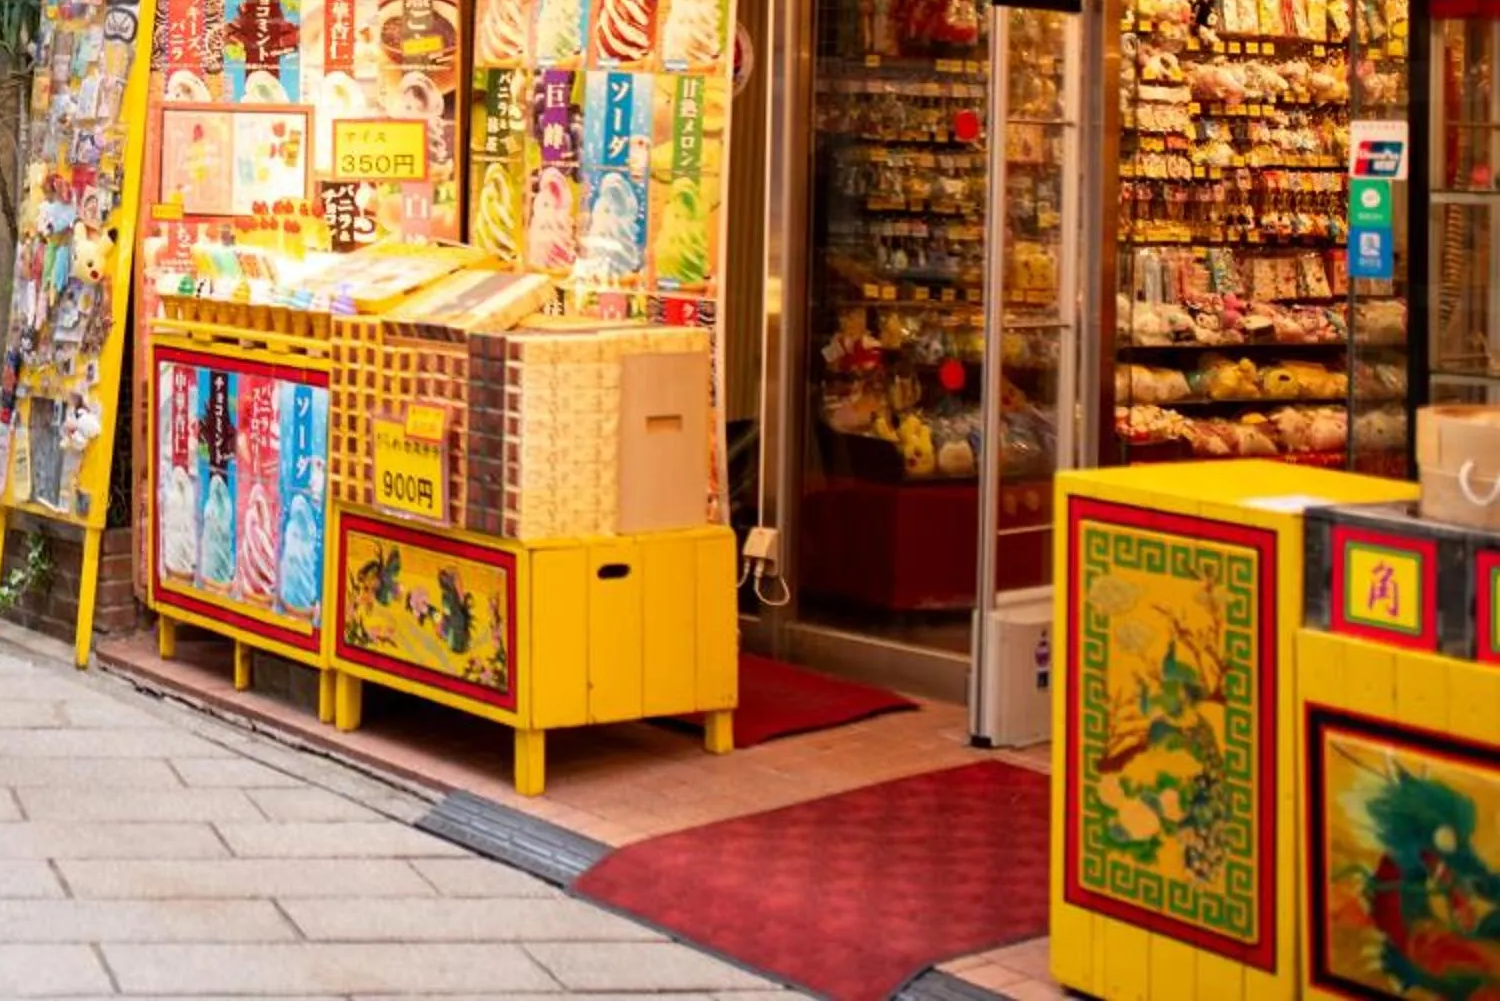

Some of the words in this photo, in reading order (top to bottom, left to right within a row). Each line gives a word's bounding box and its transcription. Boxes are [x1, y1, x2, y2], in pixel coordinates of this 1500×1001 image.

[172, 21, 187, 60] バニラ
[543, 83, 566, 148] 巨峰
[608, 81, 629, 159] ソーダ
[341, 153, 415, 175] 350円
[213, 375, 225, 465] チョコミント
[295, 396, 310, 479] ソーダ
[383, 470, 433, 509] 900円
[1368, 560, 1399, 617] 角
